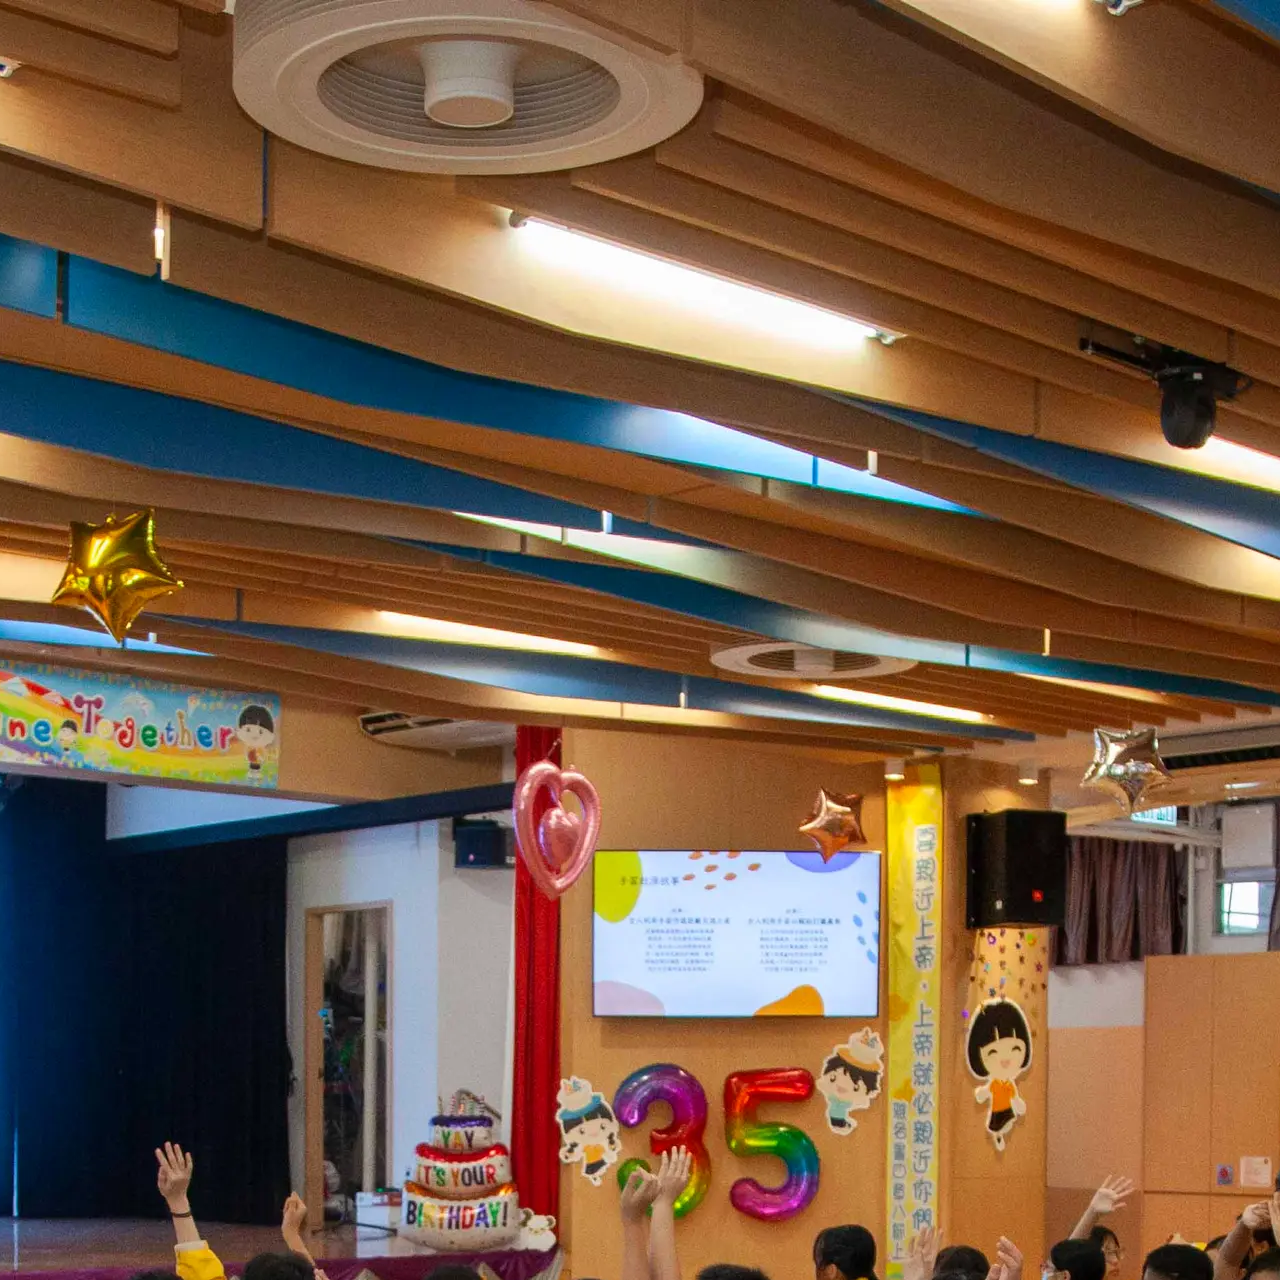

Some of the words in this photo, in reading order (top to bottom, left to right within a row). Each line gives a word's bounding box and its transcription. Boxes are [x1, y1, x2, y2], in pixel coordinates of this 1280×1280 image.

[73, 694, 234, 750] Together
[440, 1129, 475, 1150] YAY
[614, 1063, 820, 1221] 35
[451, 1164, 497, 1187] YOUR
[406, 1200, 508, 1230] BIRTHDAY!
